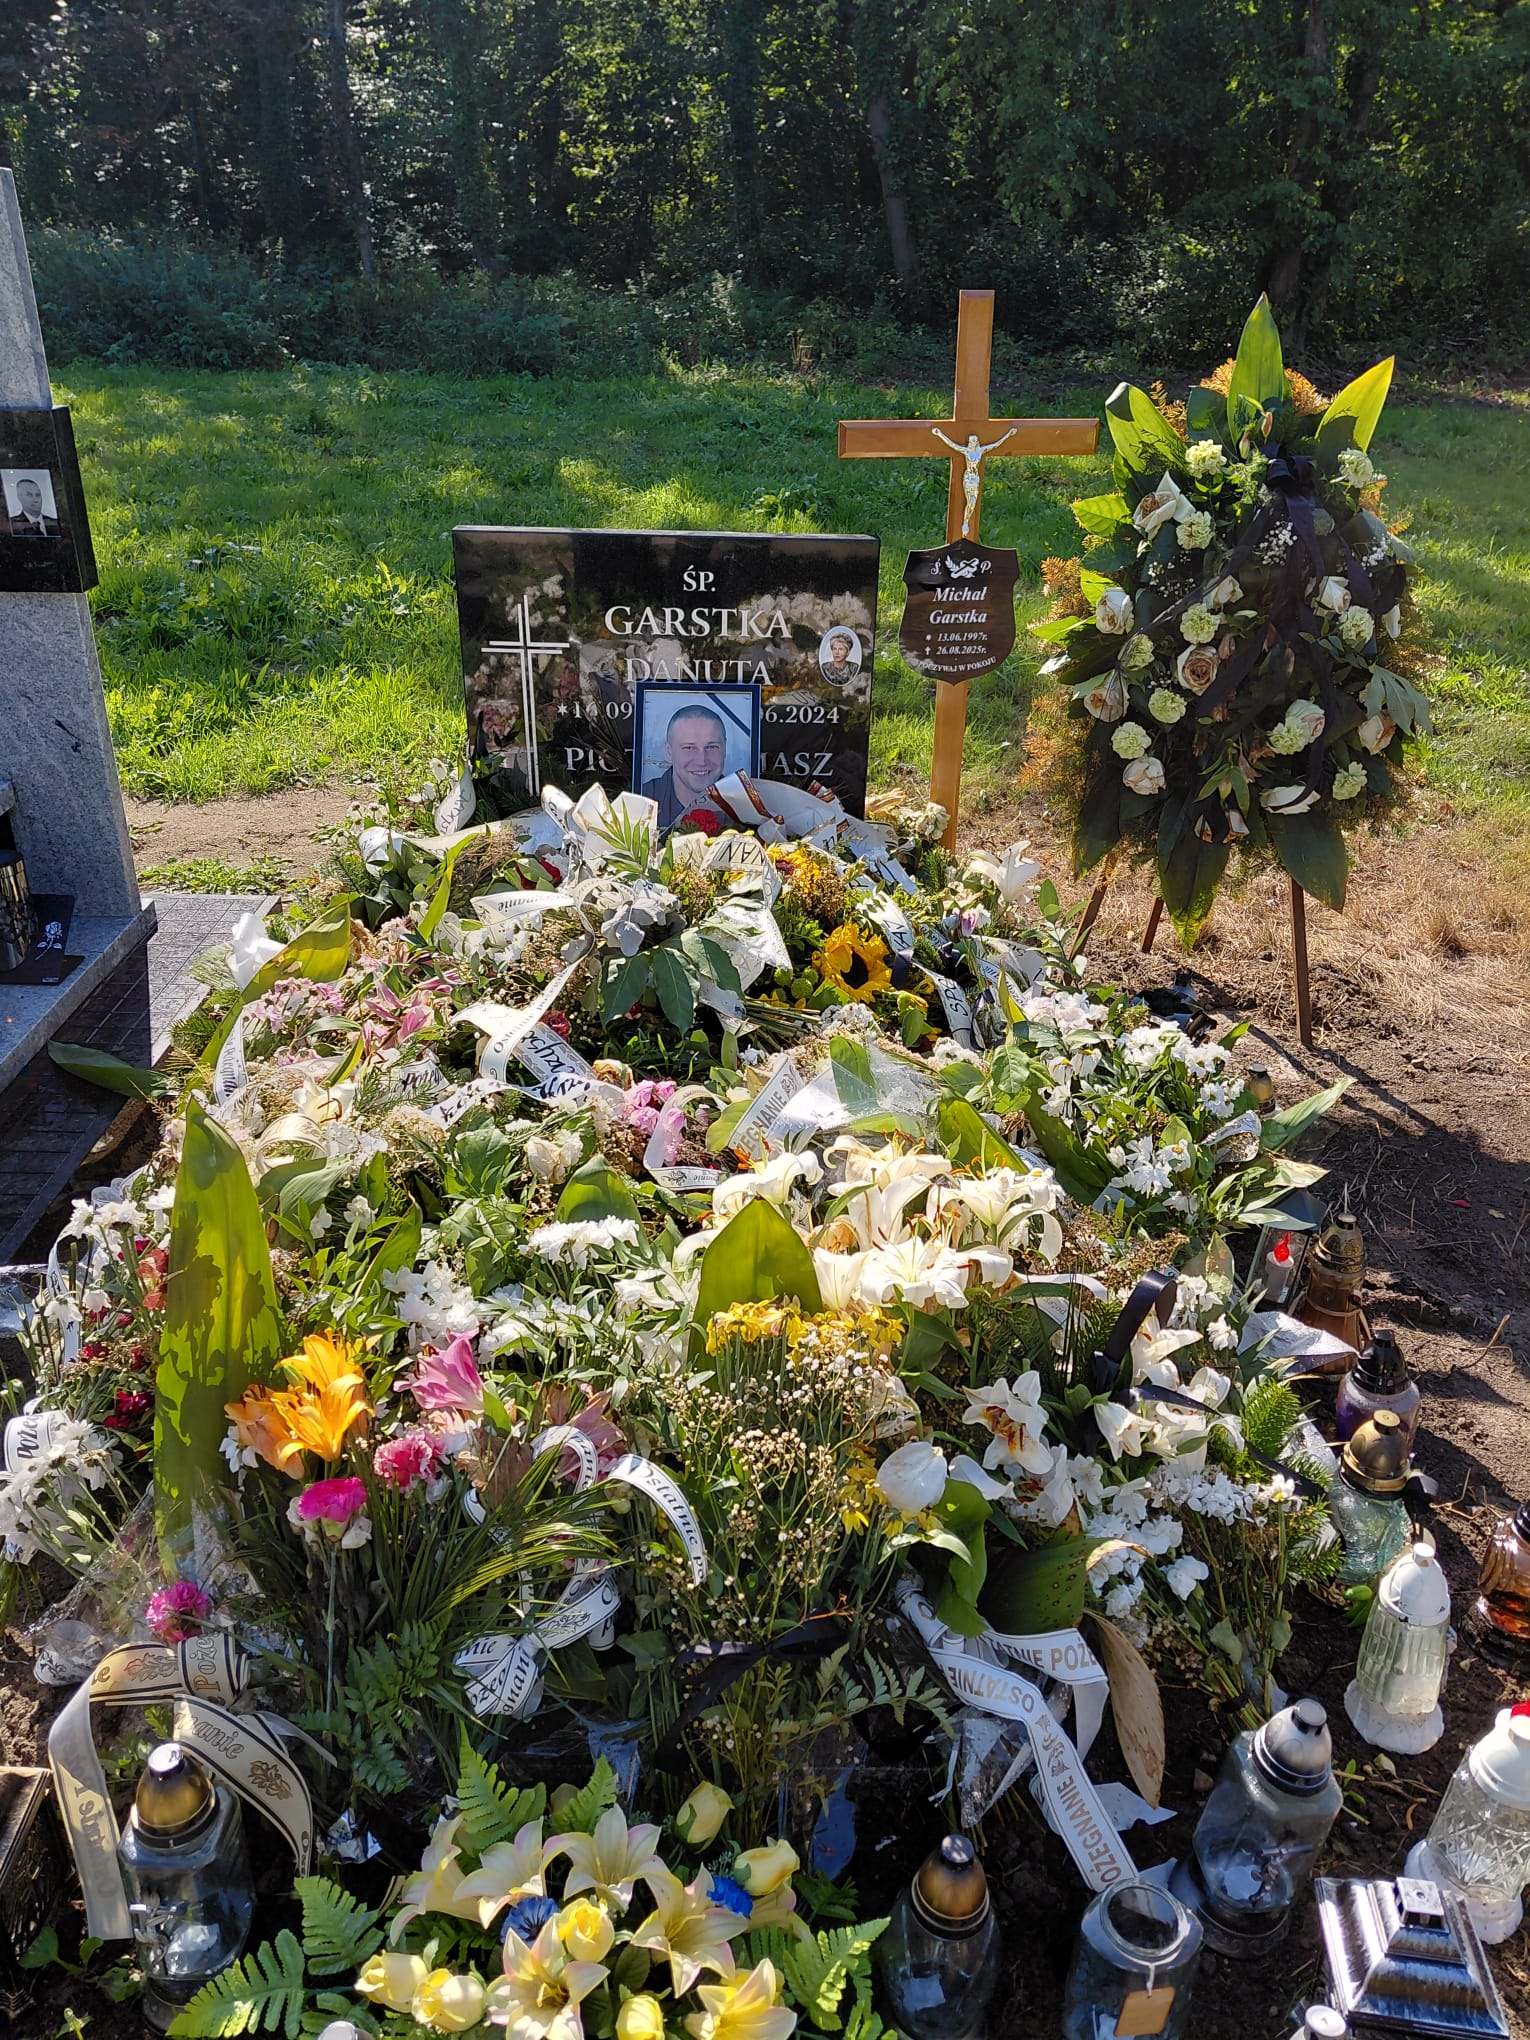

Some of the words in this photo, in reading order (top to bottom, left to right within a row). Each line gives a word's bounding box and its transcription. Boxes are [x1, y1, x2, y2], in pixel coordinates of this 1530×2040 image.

[682, 564, 717, 592] ŚP.
[931, 587, 988, 602] Michał
[604, 605, 793, 639] GARSTKA
[929, 609, 987, 625] Garstka
[624, 657, 774, 686] DANUTA
[966, 656, 997, 671] POKOJU
[759, 704, 841, 724] 6.2024
[1056, 1775, 1122, 1884] OŻEGNANIE
